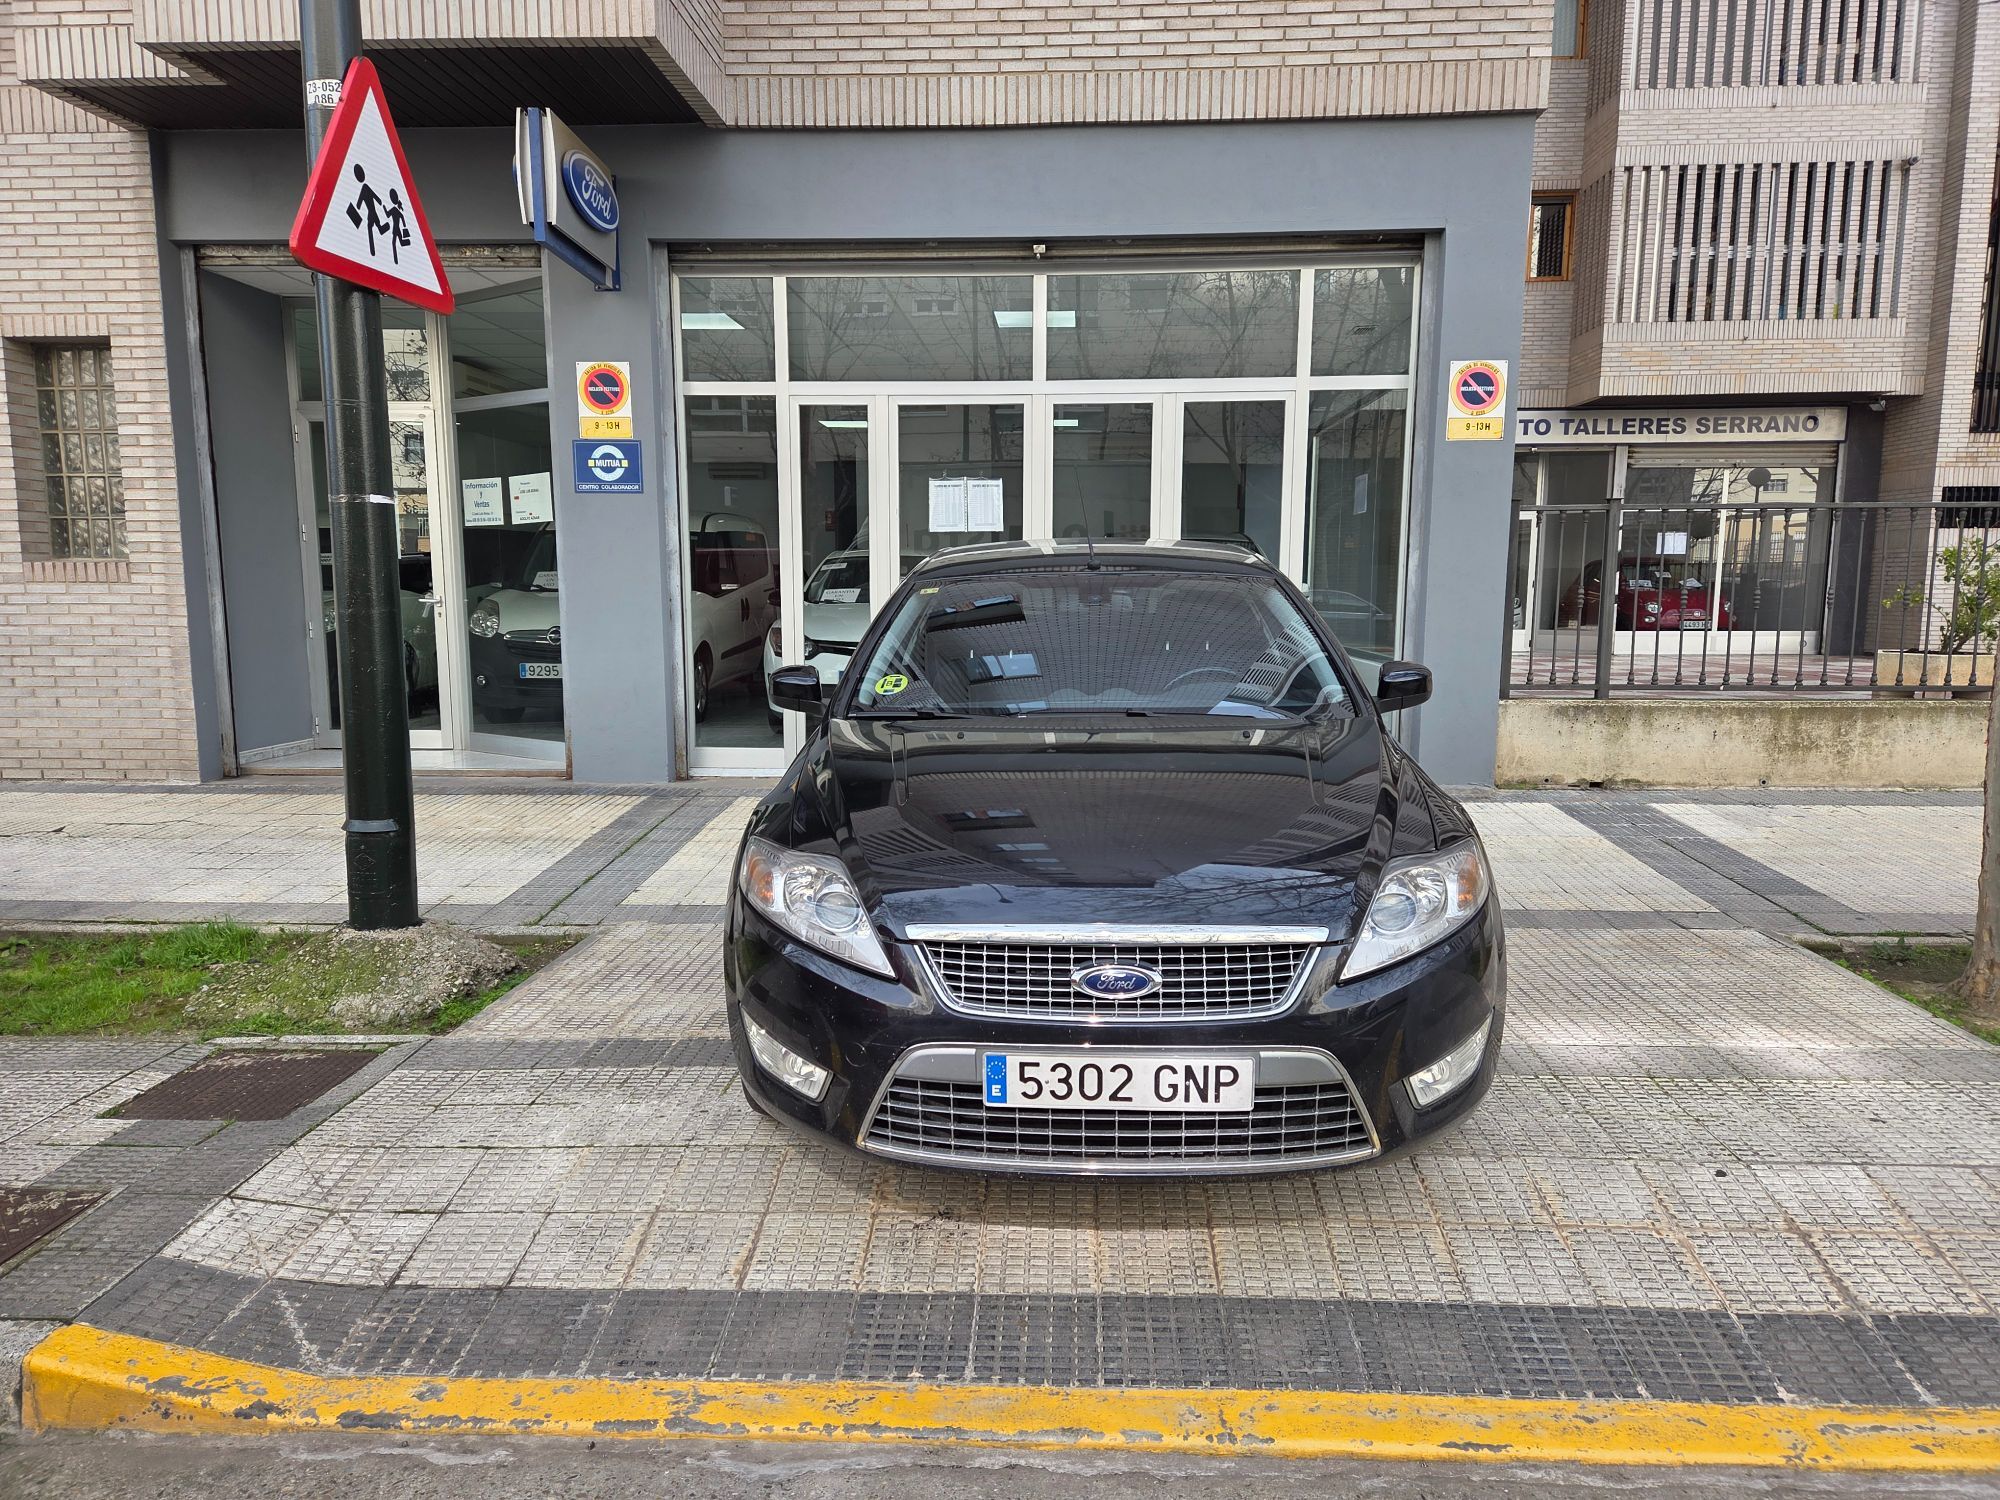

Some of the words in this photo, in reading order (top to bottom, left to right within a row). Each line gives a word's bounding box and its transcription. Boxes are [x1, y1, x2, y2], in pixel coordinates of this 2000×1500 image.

[582, 165, 611, 219] Ford
[1559, 417, 1687, 436] TALLERES
[1695, 415, 1820, 435] SERRANO
[595, 459, 621, 468] MUTUA
[464, 481, 498, 490] Información
[473, 500, 490, 508] Ventas
[528, 665, 560, 677] 9295
[1097, 972, 1136, 990] Ford
[1018, 1061, 1134, 1102] 5302
[1153, 1064, 1240, 1104] GNP
[991, 1085, 1002, 1097] E
